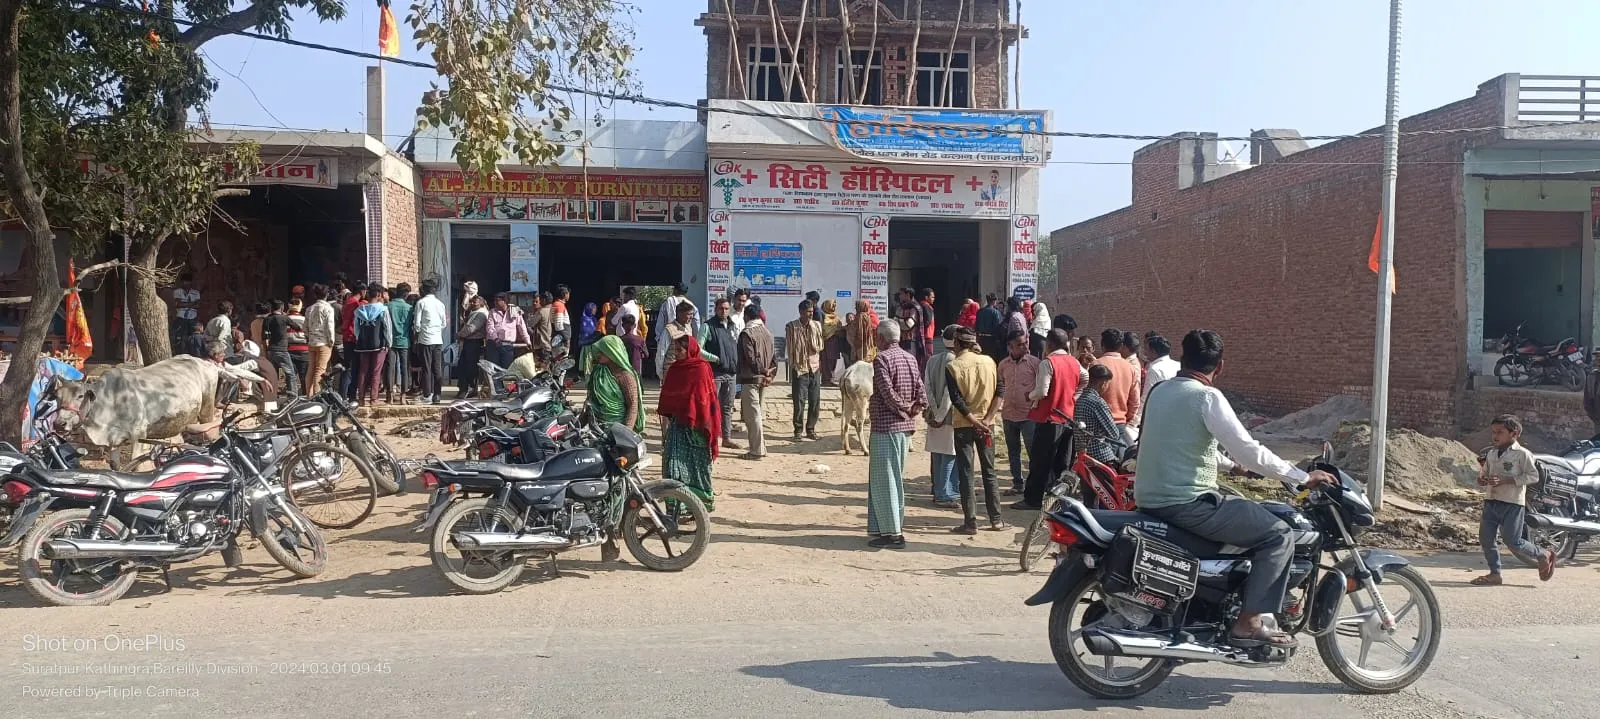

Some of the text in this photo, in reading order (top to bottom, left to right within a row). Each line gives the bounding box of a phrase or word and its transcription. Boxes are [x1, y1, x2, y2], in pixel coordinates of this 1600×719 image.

[717, 162, 742, 174] CHK
[767, 163, 954, 193] सिटी हॉस्पिटल
[426, 177, 568, 194] AL-BAREILLY
[574, 181, 700, 197] FURNITURE
[713, 212, 729, 222] CHK
[866, 217, 888, 227] CHK
[1016, 217, 1037, 227] CHK
[709, 240, 730, 254] सिटी
[862, 241, 887, 255] सिटी
[1013, 240, 1037, 254] सिटी
